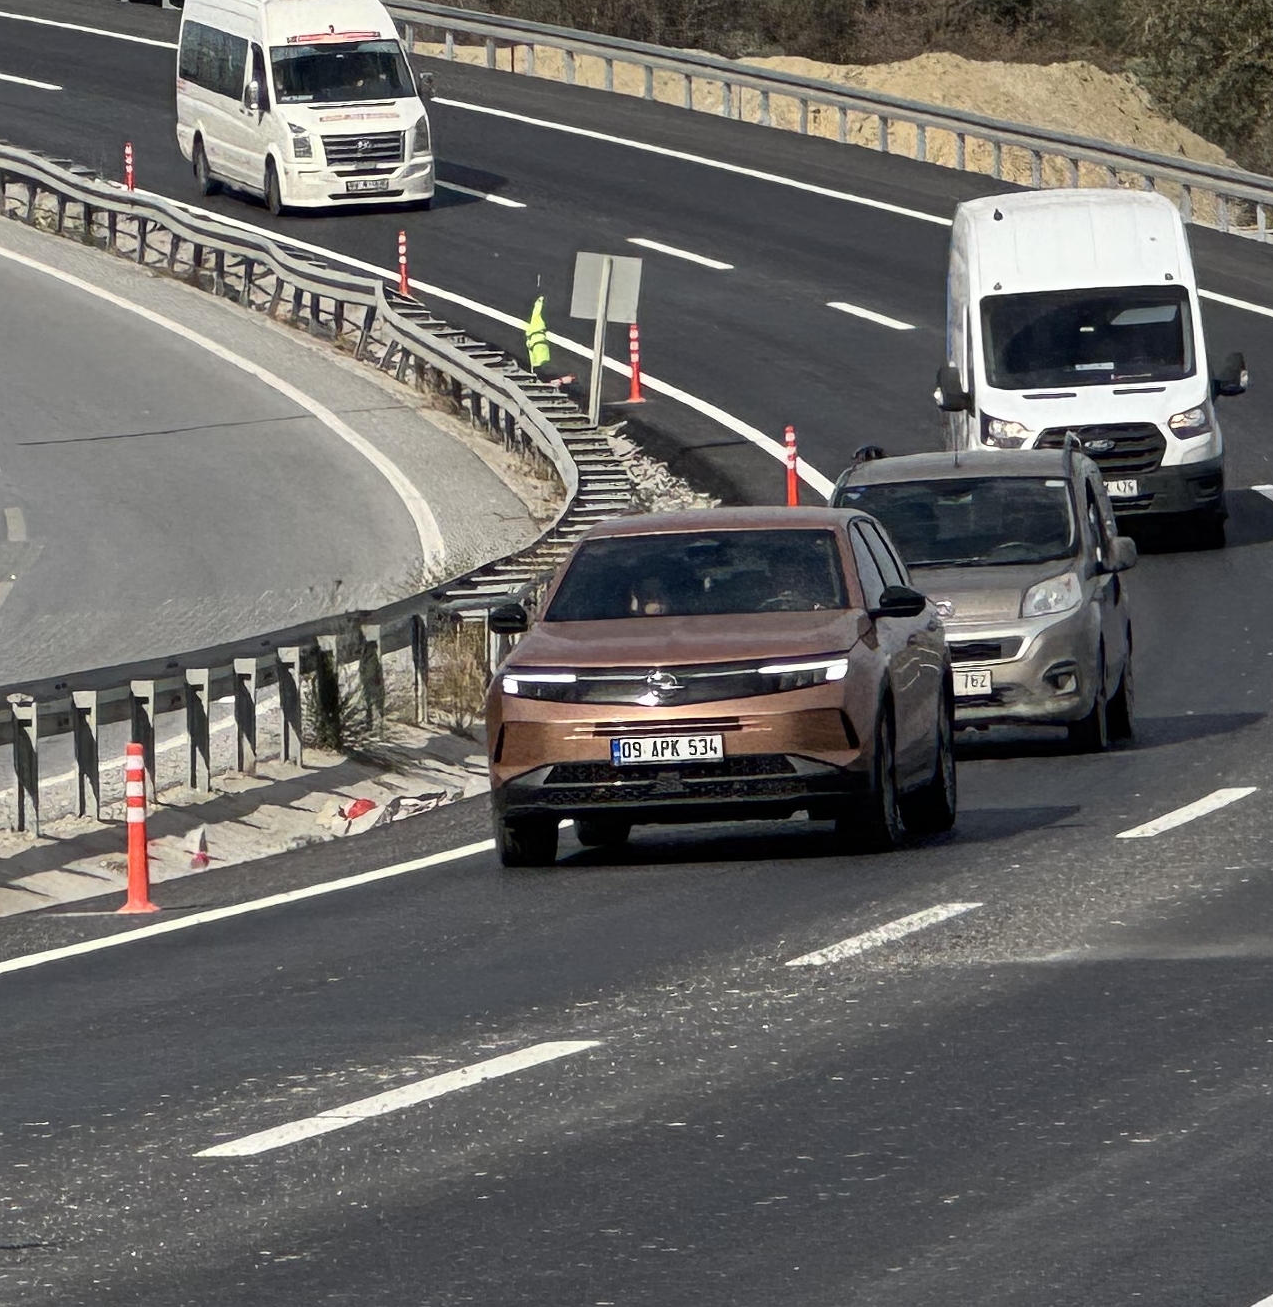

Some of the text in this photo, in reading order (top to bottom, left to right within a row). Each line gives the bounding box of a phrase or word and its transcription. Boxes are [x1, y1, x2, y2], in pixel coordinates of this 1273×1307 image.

[622, 738, 718, 759] 09 APK 534
